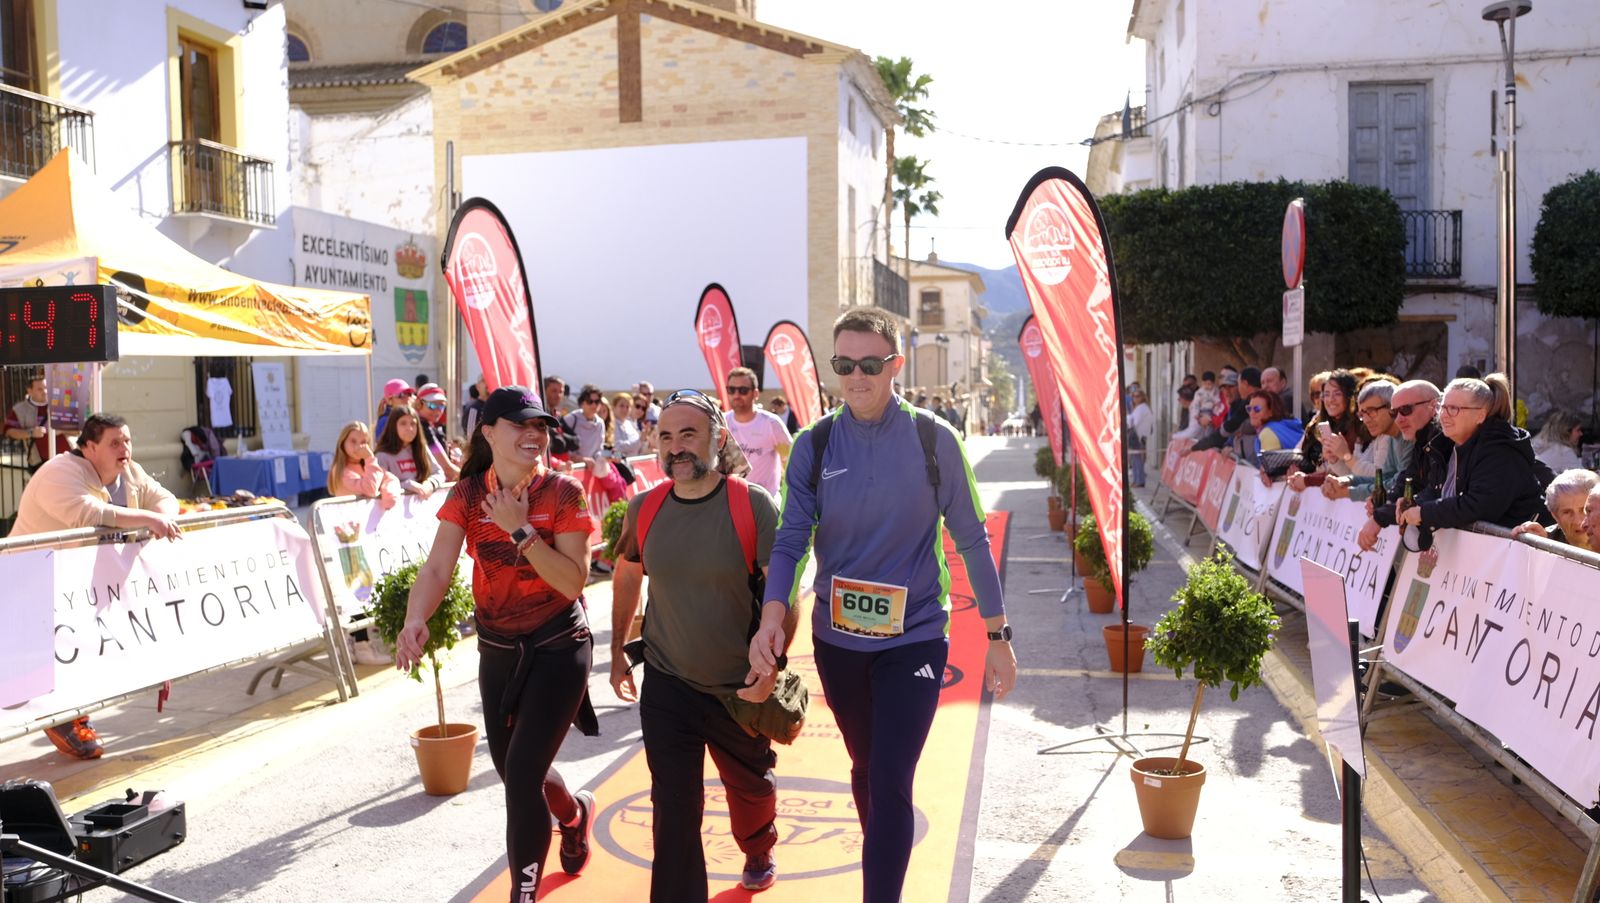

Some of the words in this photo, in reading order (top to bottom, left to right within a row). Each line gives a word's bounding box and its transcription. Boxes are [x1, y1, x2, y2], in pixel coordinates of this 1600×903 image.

[302, 234, 389, 266] EXCELENTÍSIMO
[305, 264, 388, 292] AYUNTAMIENTO
[54, 556, 257, 612] YUNTAMIENTO
[265, 549, 290, 569] DE
[1292, 530, 1379, 600] CANTORIA
[54, 574, 305, 664] CANTORIA
[843, 592, 890, 616] 606
[1423, 600, 1600, 740] CANTORIA
[519, 862, 539, 903] FILA
